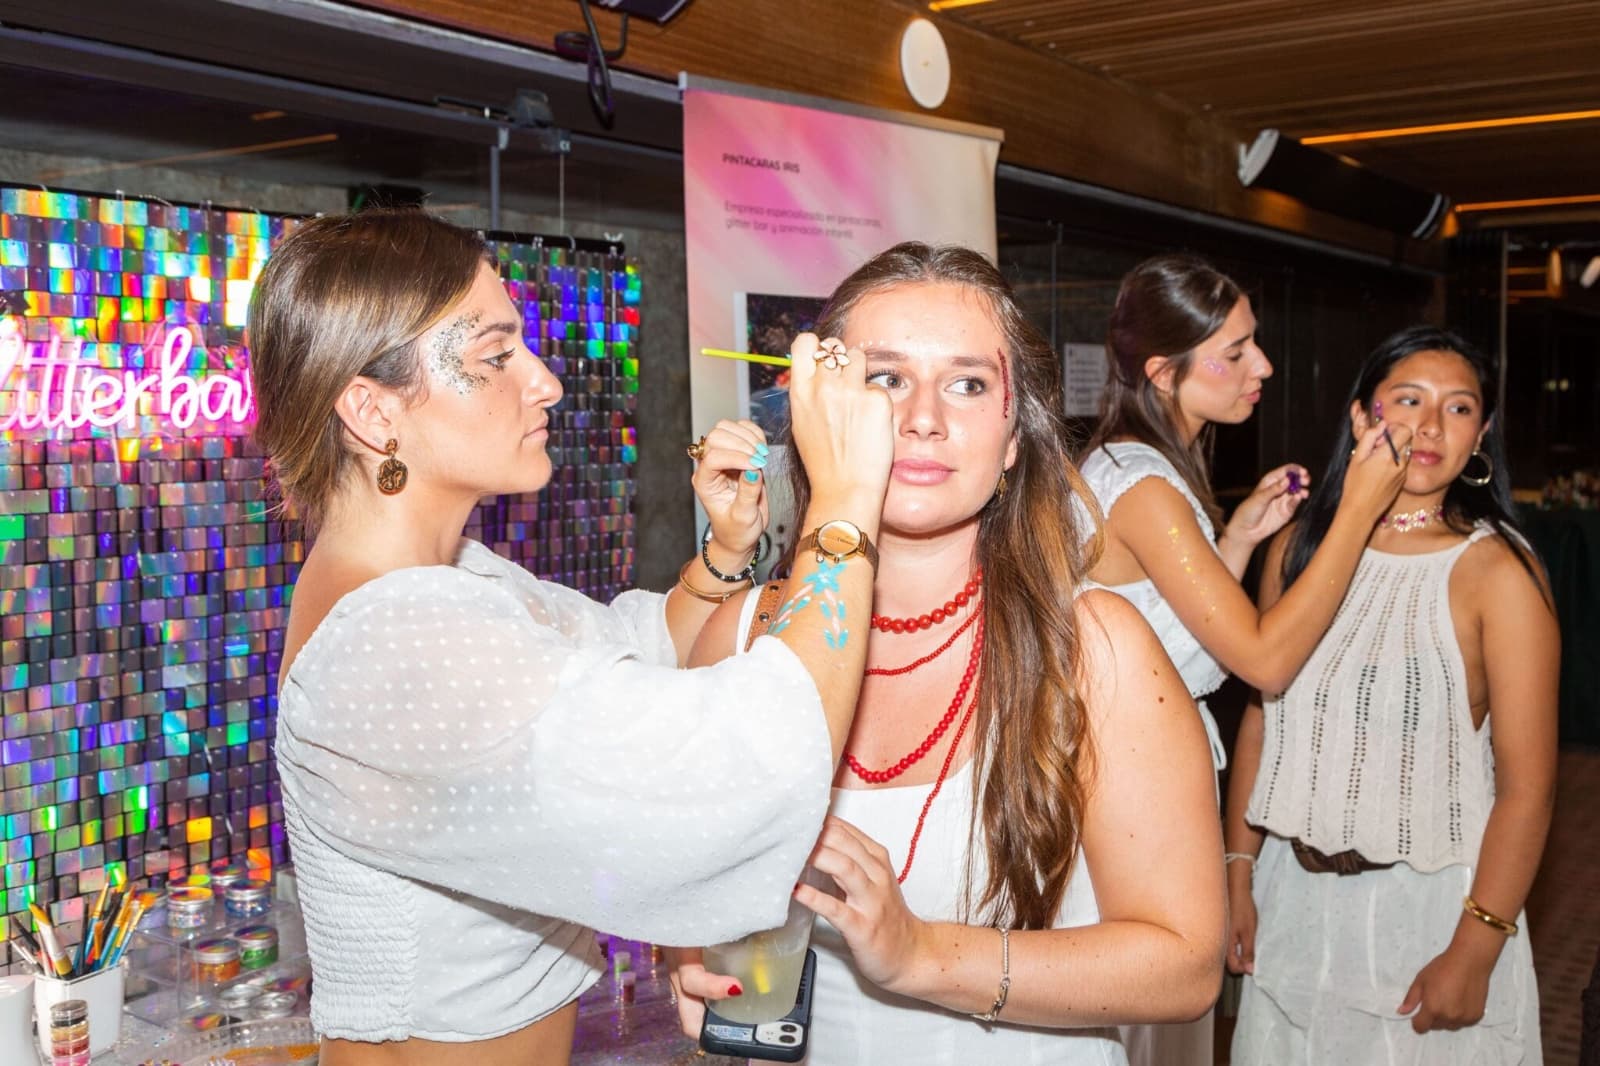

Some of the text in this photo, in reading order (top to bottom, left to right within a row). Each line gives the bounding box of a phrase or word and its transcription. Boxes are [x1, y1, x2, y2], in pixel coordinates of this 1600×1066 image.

[722, 153, 800, 174] PINTACARAS IRIS
[724, 200, 765, 215] Empresa
[753, 219, 768, 231] bar
